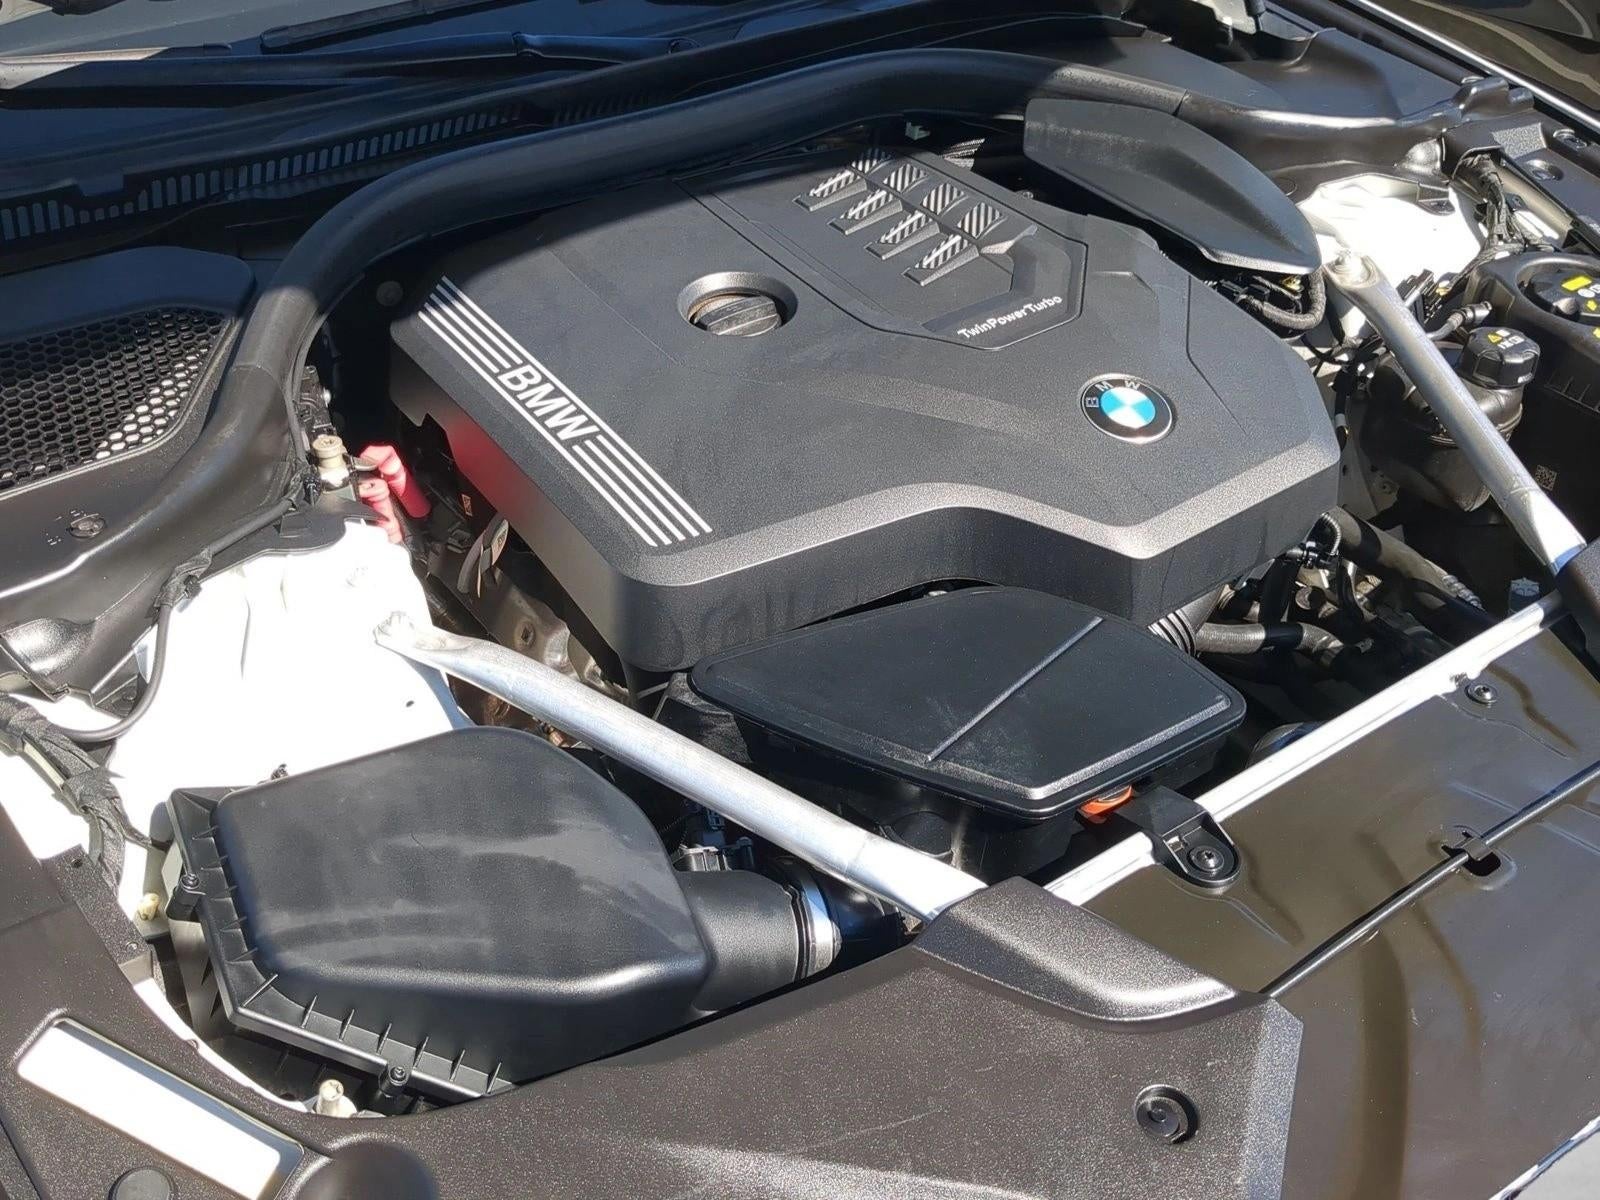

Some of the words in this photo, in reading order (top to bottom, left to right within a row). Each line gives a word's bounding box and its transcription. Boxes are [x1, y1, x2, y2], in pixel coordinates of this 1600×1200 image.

[957, 296, 1063, 338] TwinPowerTurbo
[497, 364, 600, 441] BMW
[1085, 380, 1141, 408] BMW
